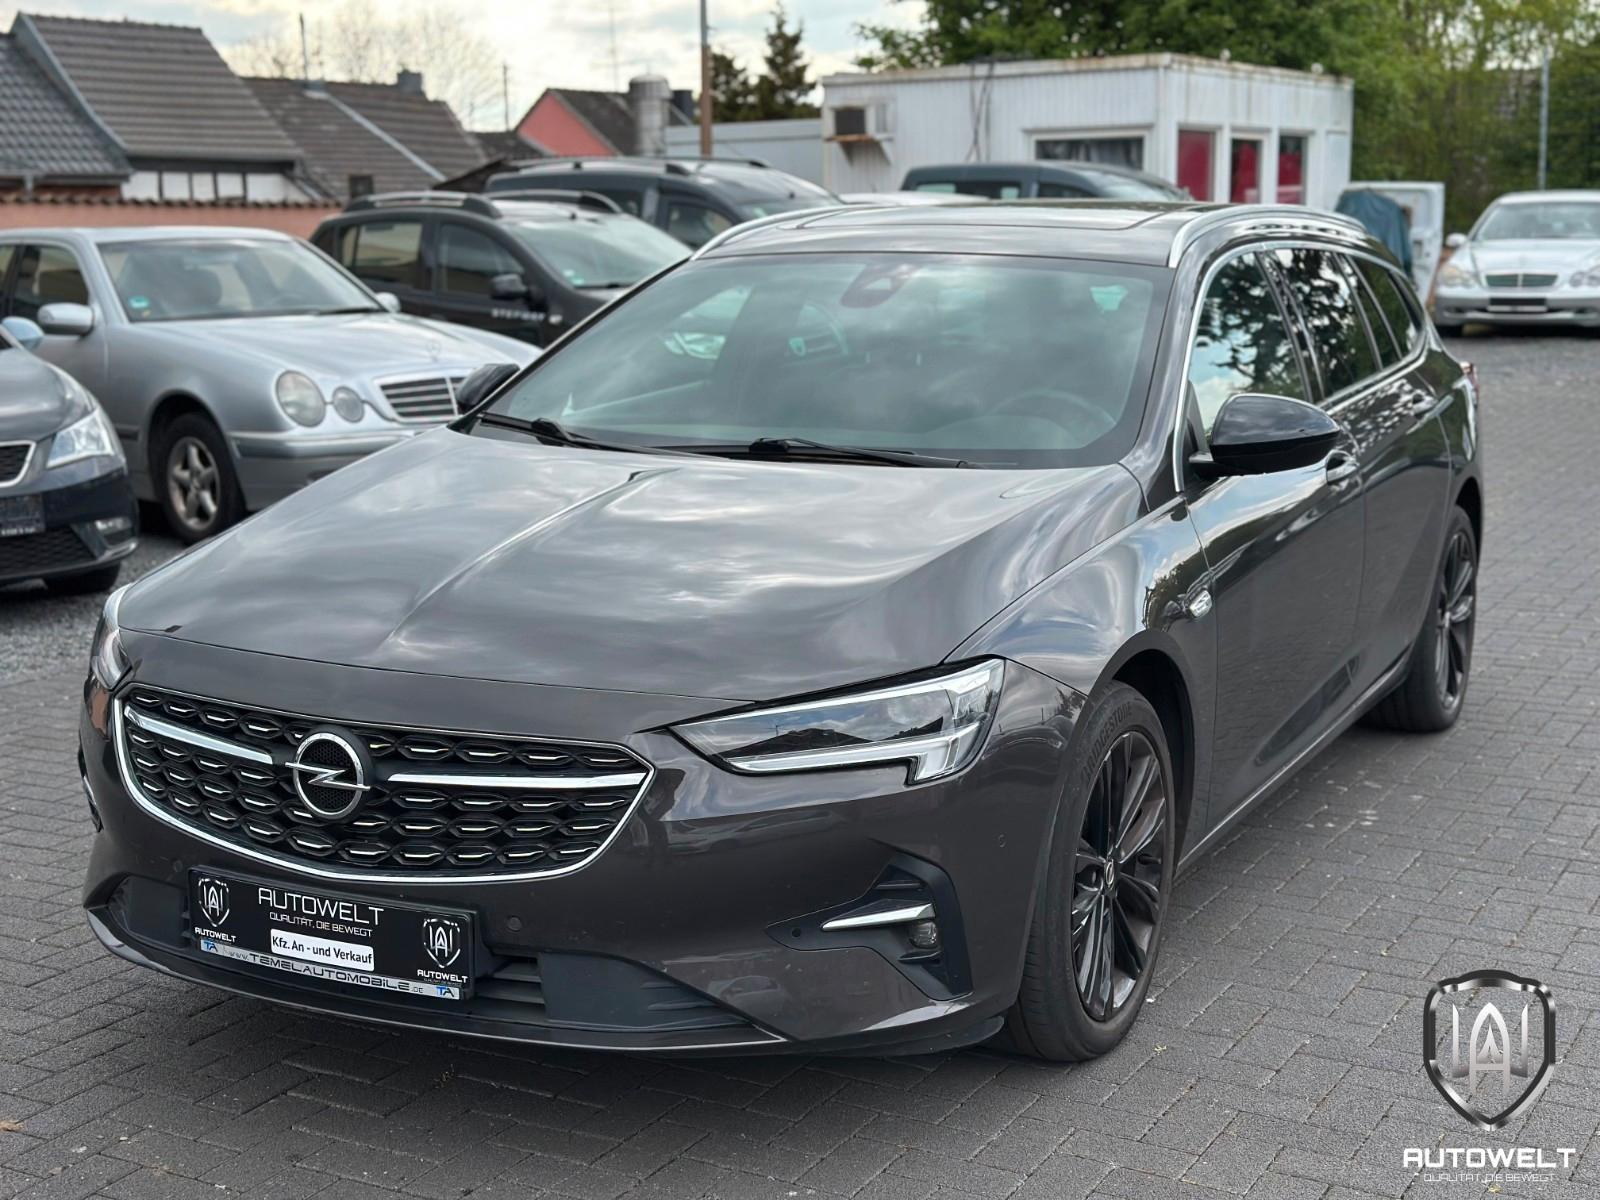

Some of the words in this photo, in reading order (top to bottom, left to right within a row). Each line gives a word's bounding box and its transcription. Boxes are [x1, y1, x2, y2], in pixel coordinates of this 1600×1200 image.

[258, 887, 384, 925] AUTOWELT
[194, 926, 237, 943] AUTOWELT
[316, 920, 331, 930] DIE
[331, 923, 373, 937] BEWEGT
[272, 936, 290, 950] Kfz.
[312, 947, 331, 957] und
[333, 947, 373, 964] Verkauf
[417, 968, 469, 984] AUTOWELT
